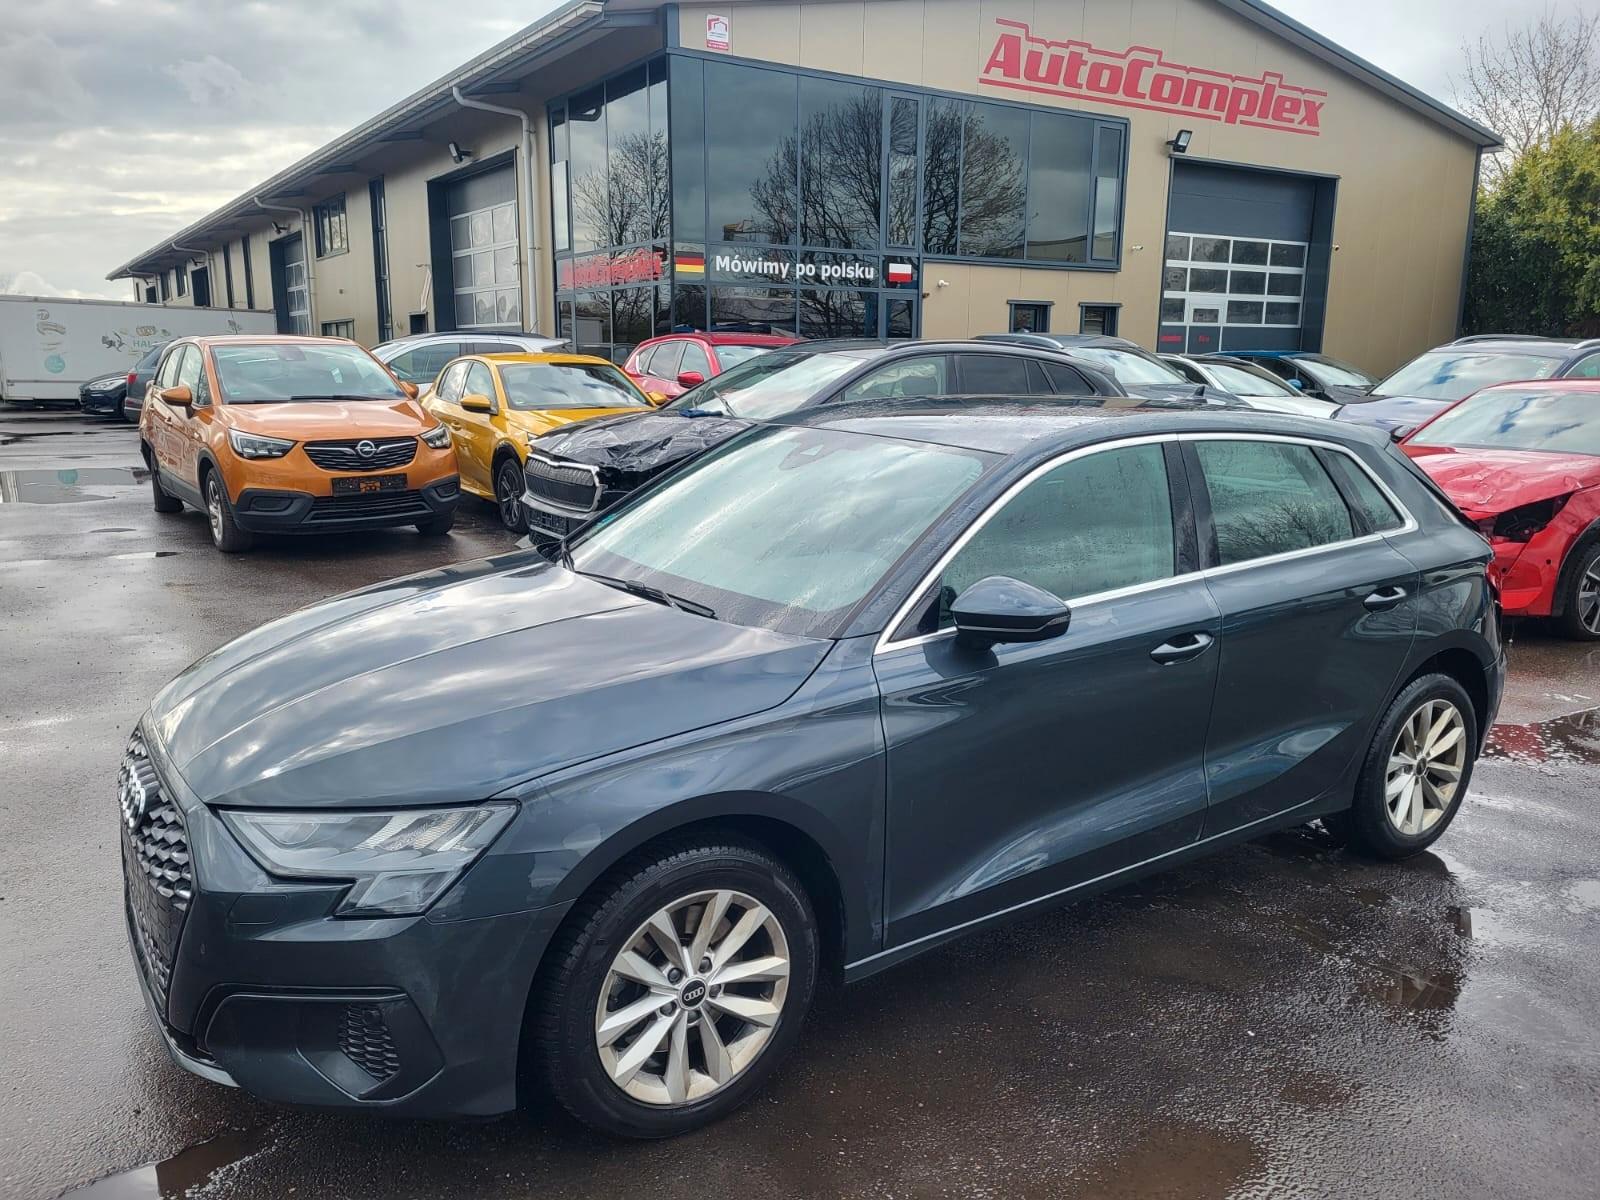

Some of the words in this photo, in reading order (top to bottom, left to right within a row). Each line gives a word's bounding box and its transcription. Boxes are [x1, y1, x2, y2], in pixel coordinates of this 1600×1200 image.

[983, 32, 1325, 129] AutoComplex
[715, 255, 790, 279] Mówimy
[796, 262, 816, 279] po
[821, 262, 875, 280] polsku
